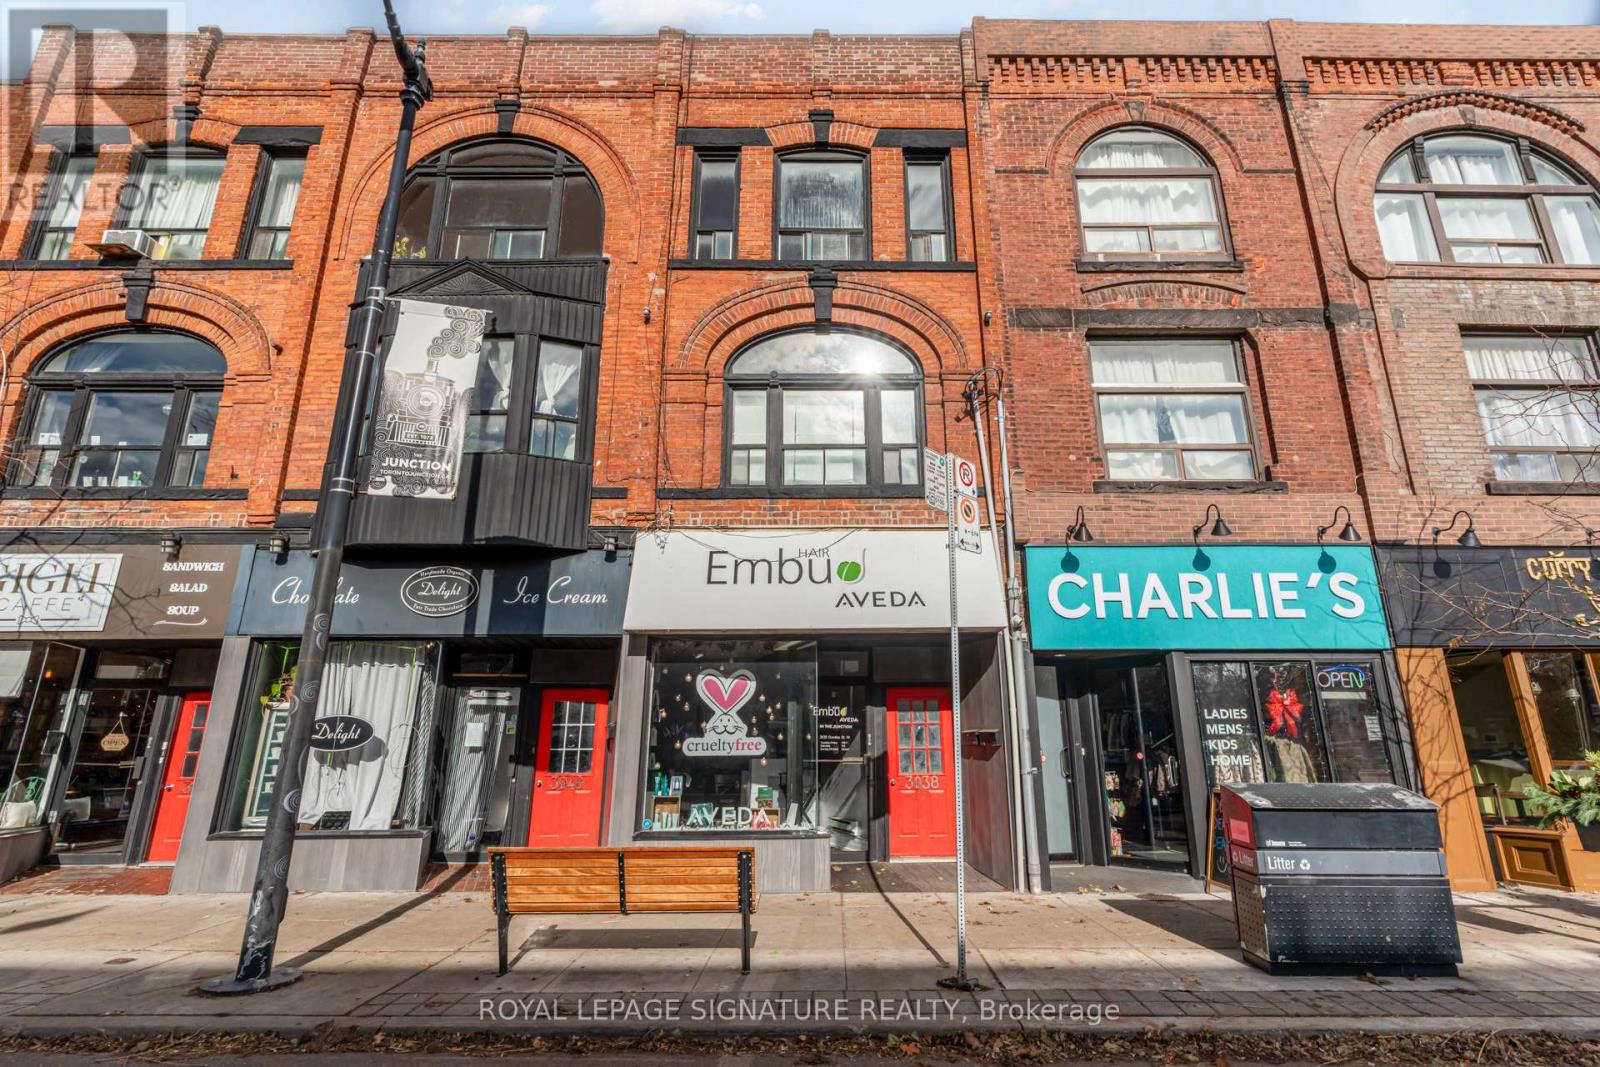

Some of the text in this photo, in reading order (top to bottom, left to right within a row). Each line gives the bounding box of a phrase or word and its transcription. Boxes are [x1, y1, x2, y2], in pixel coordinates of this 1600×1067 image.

[381, 457, 451, 471] JUNCTION
[799, 547, 830, 558] HAIR
[163, 562, 224, 572] SANDWICH
[0, 563, 101, 593] IGLI
[169, 583, 208, 593] SALAD
[418, 581, 461, 599] Delight
[503, 576, 608, 603] Ice Cream
[835, 591, 927, 608] AVEDA
[1047, 572, 1366, 619] CHARLIE'S
[167, 605, 199, 615] SOUP
[1316, 671, 1364, 688] OPEN
[1204, 709, 1248, 719] LADIES
[311, 722, 361, 744] Delight
[1206, 724, 1243, 735] MENS
[1208, 740, 1238, 750] KIDS
[1211, 755, 1250, 766] HOME
[687, 807, 773, 826] AVEDA
[1267, 855, 1295, 870] Litter
